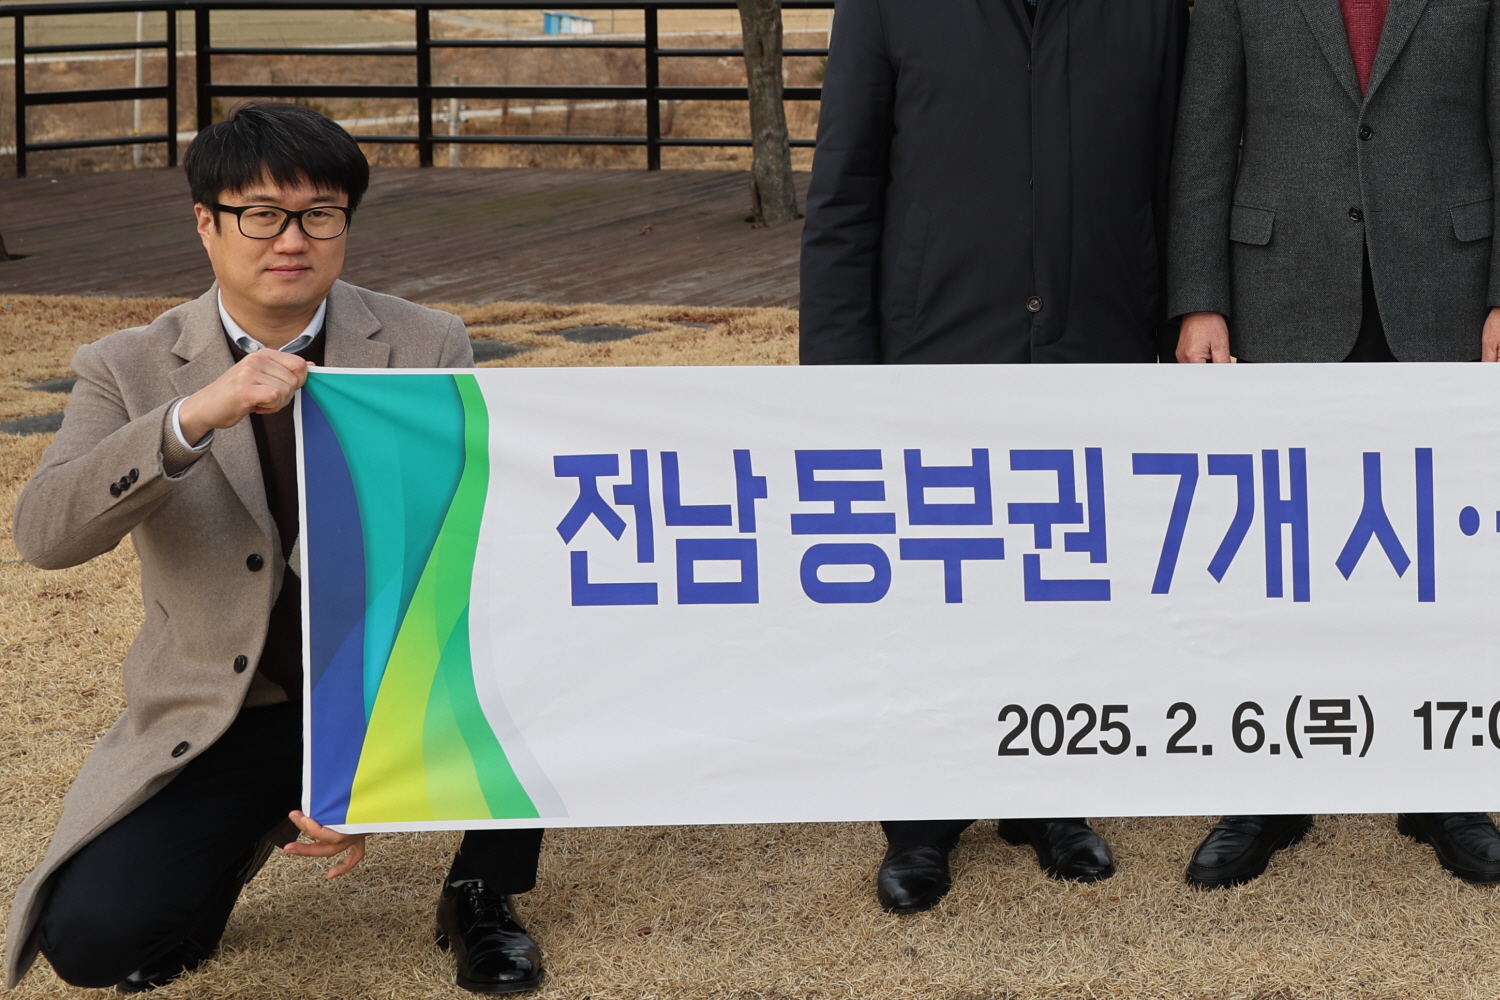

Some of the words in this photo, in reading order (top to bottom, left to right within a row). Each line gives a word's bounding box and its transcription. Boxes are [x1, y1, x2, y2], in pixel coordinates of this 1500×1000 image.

[553, 448, 768, 606] 전남
[790, 447, 1111, 604] 동부권
[1131, 447, 1311, 603] 7개
[997, 702, 1147, 757] 2025.
[1166, 701, 1213, 756] 2.
